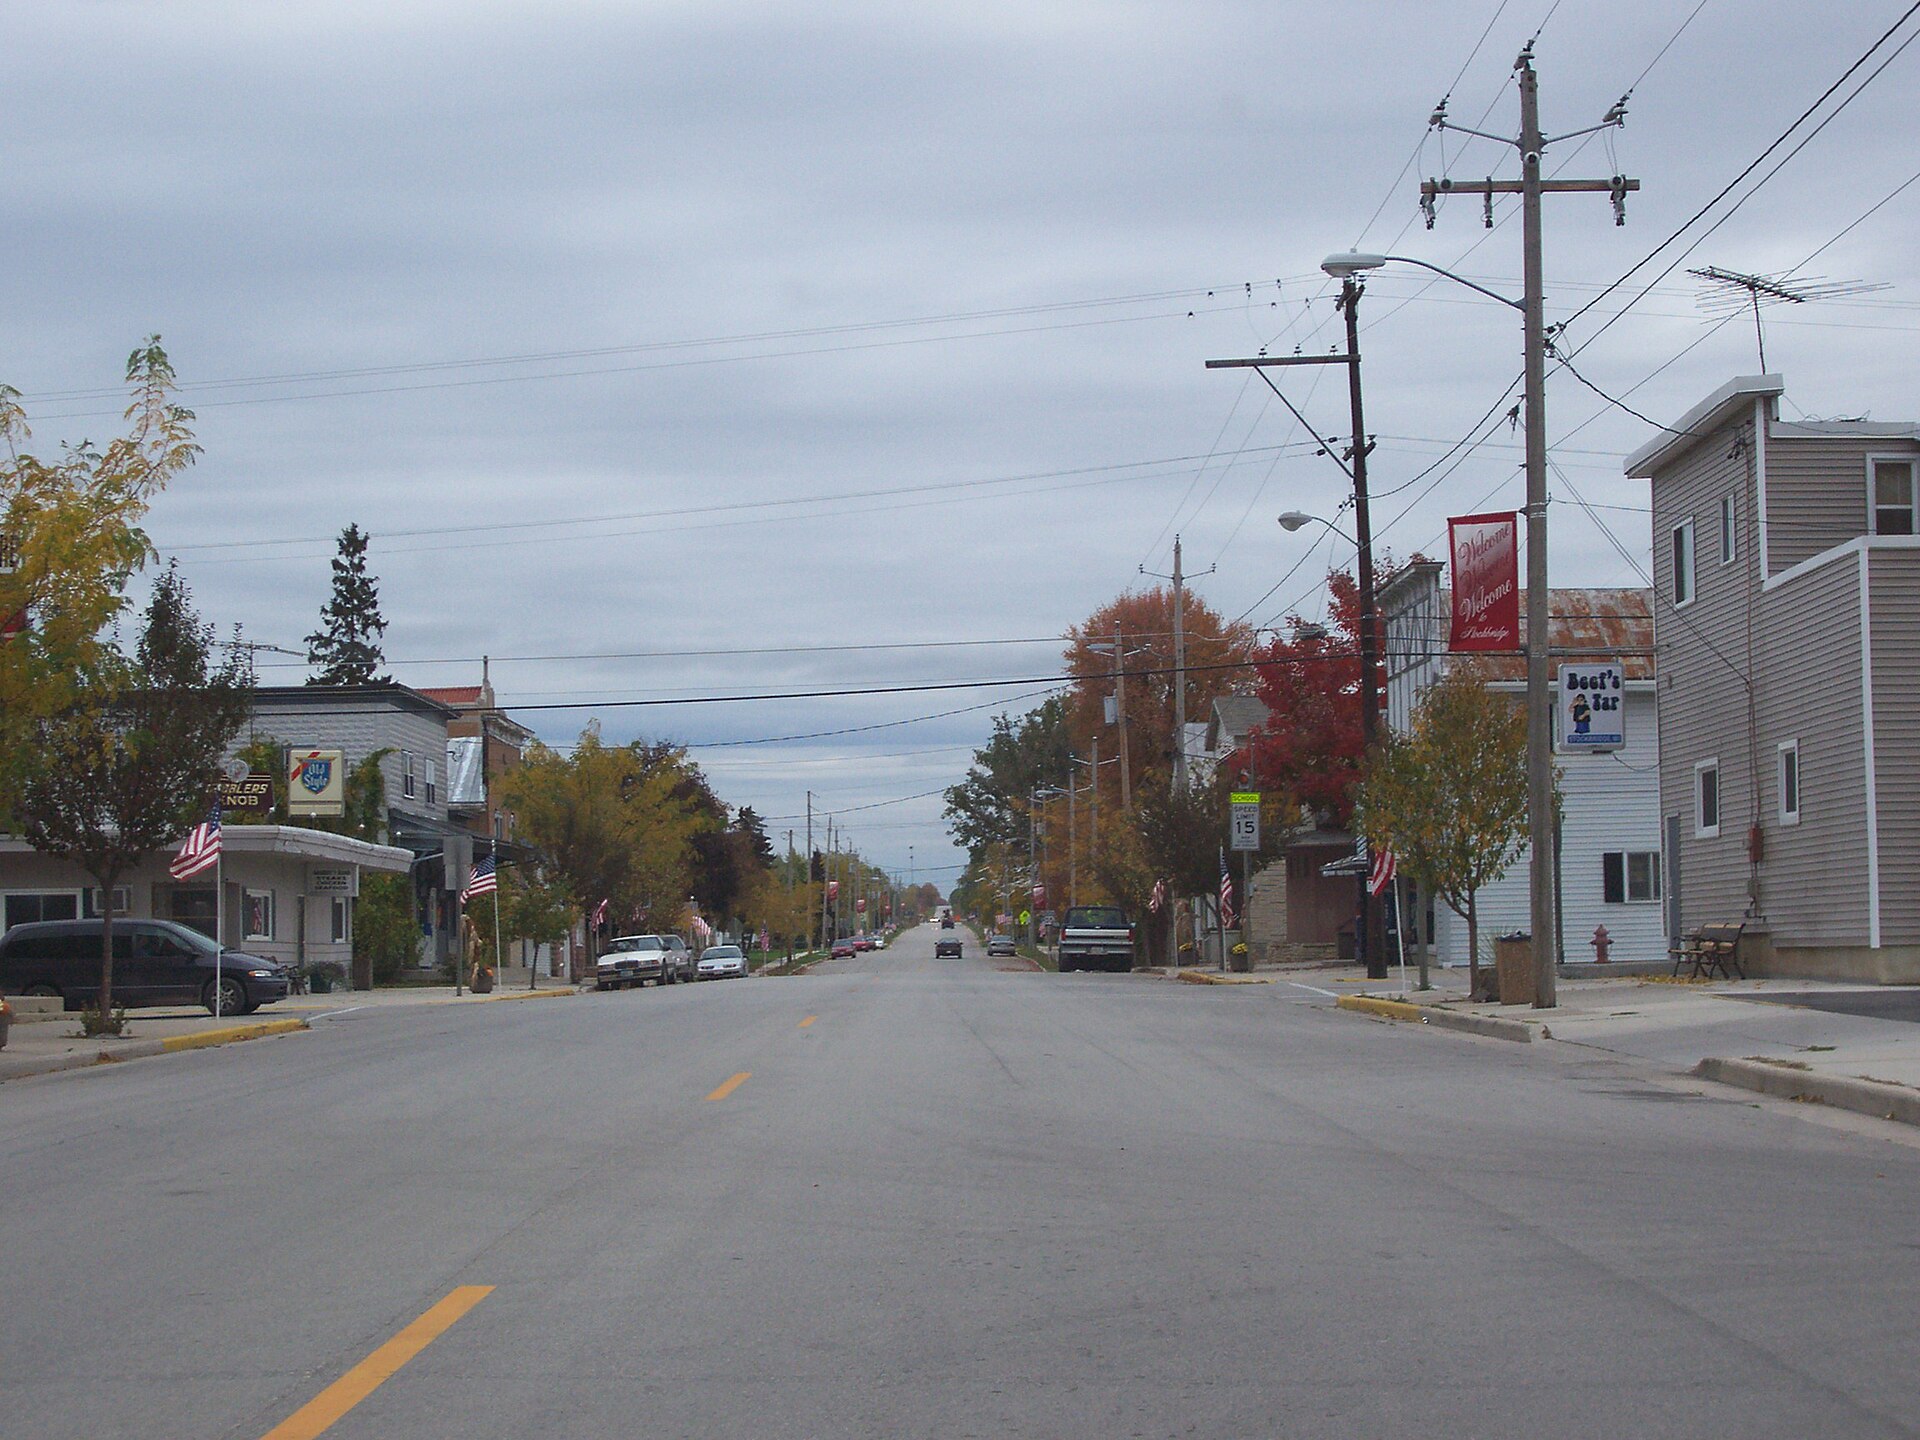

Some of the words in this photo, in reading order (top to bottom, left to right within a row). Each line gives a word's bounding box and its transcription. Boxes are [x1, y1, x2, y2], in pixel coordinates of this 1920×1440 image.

[1457, 523, 1511, 566] Welcome
[1458, 579, 1512, 623] Welcome
[1567, 669, 1620, 690] Beef's
[308, 762, 326, 776] Old
[303, 774, 326, 790] Style
[1236, 821, 1255, 834] 15
